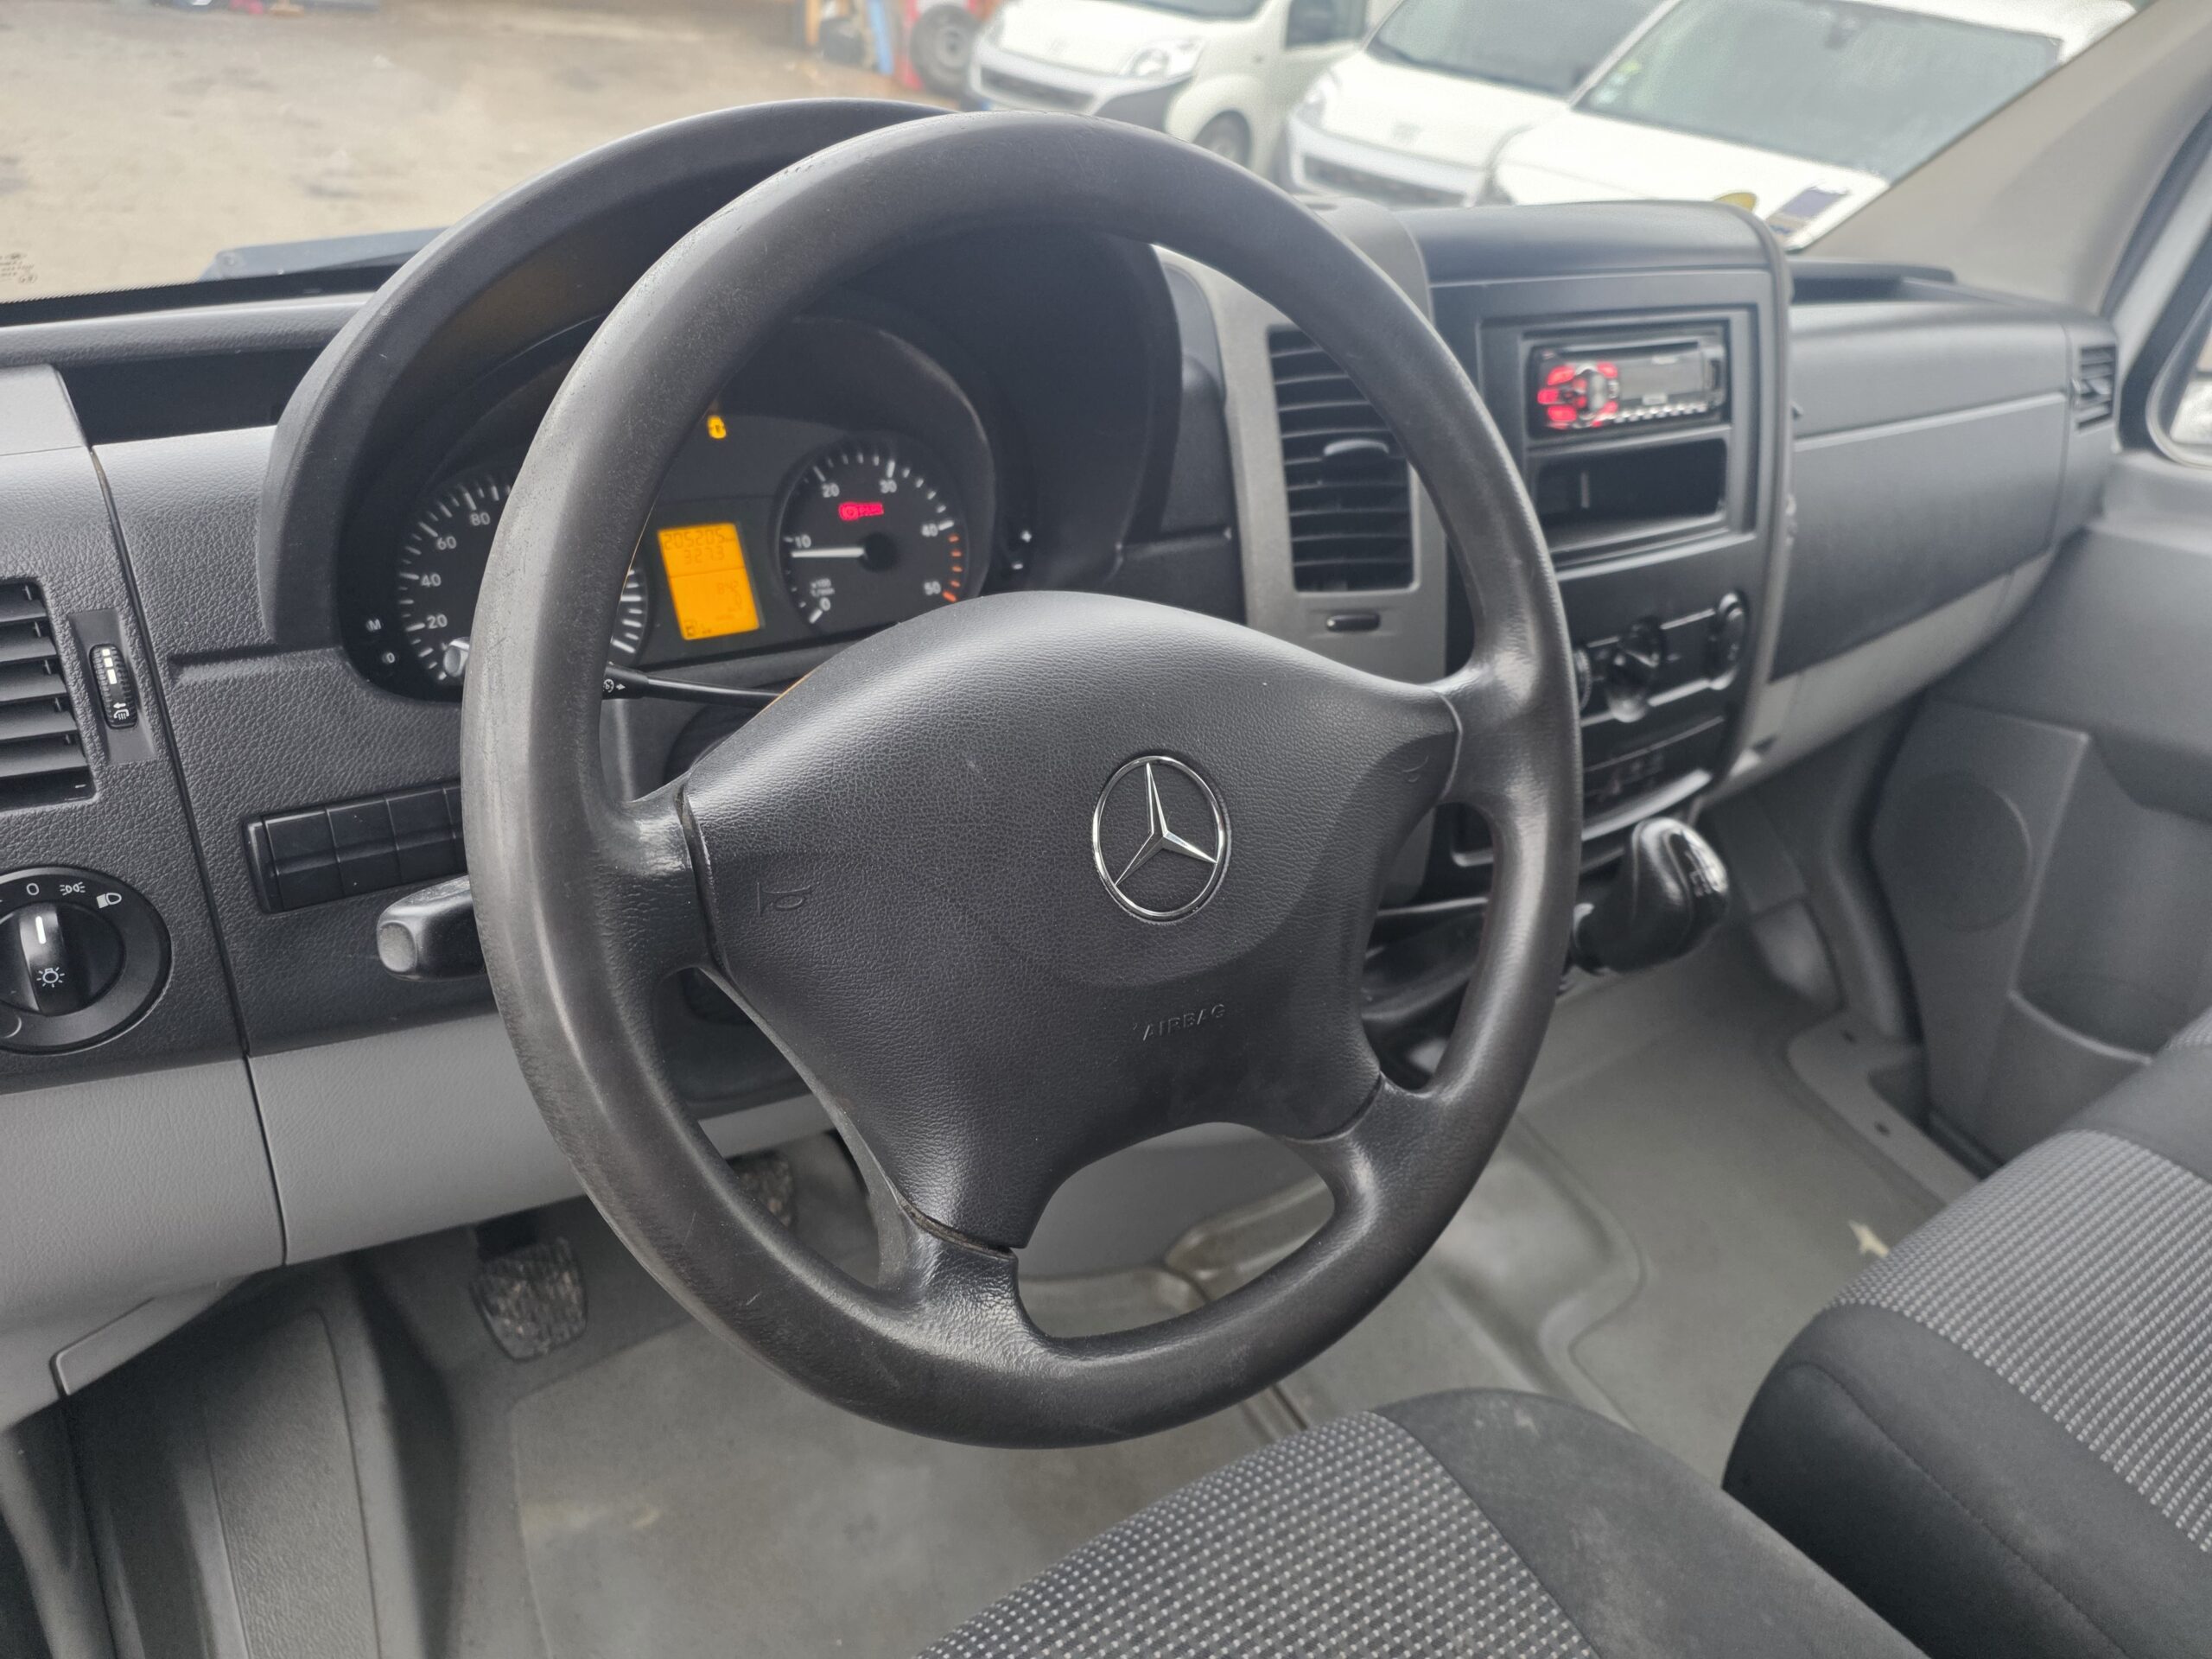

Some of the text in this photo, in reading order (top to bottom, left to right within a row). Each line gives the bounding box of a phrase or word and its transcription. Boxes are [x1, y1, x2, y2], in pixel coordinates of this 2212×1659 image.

[823, 483, 840, 498] 20
[880, 480, 898, 493] 30
[470, 512, 490, 526] 80
[921, 523, 938, 537] 40
[436, 536, 457, 550] 60
[795, 534, 811, 549] 10
[421, 573, 442, 588] 40
[924, 581, 941, 596] 50
[819, 597, 831, 612] 0
[366, 619, 382, 632] M
[426, 613, 448, 629] 20
[1142, 1003, 1226, 1041] AIRBAG
